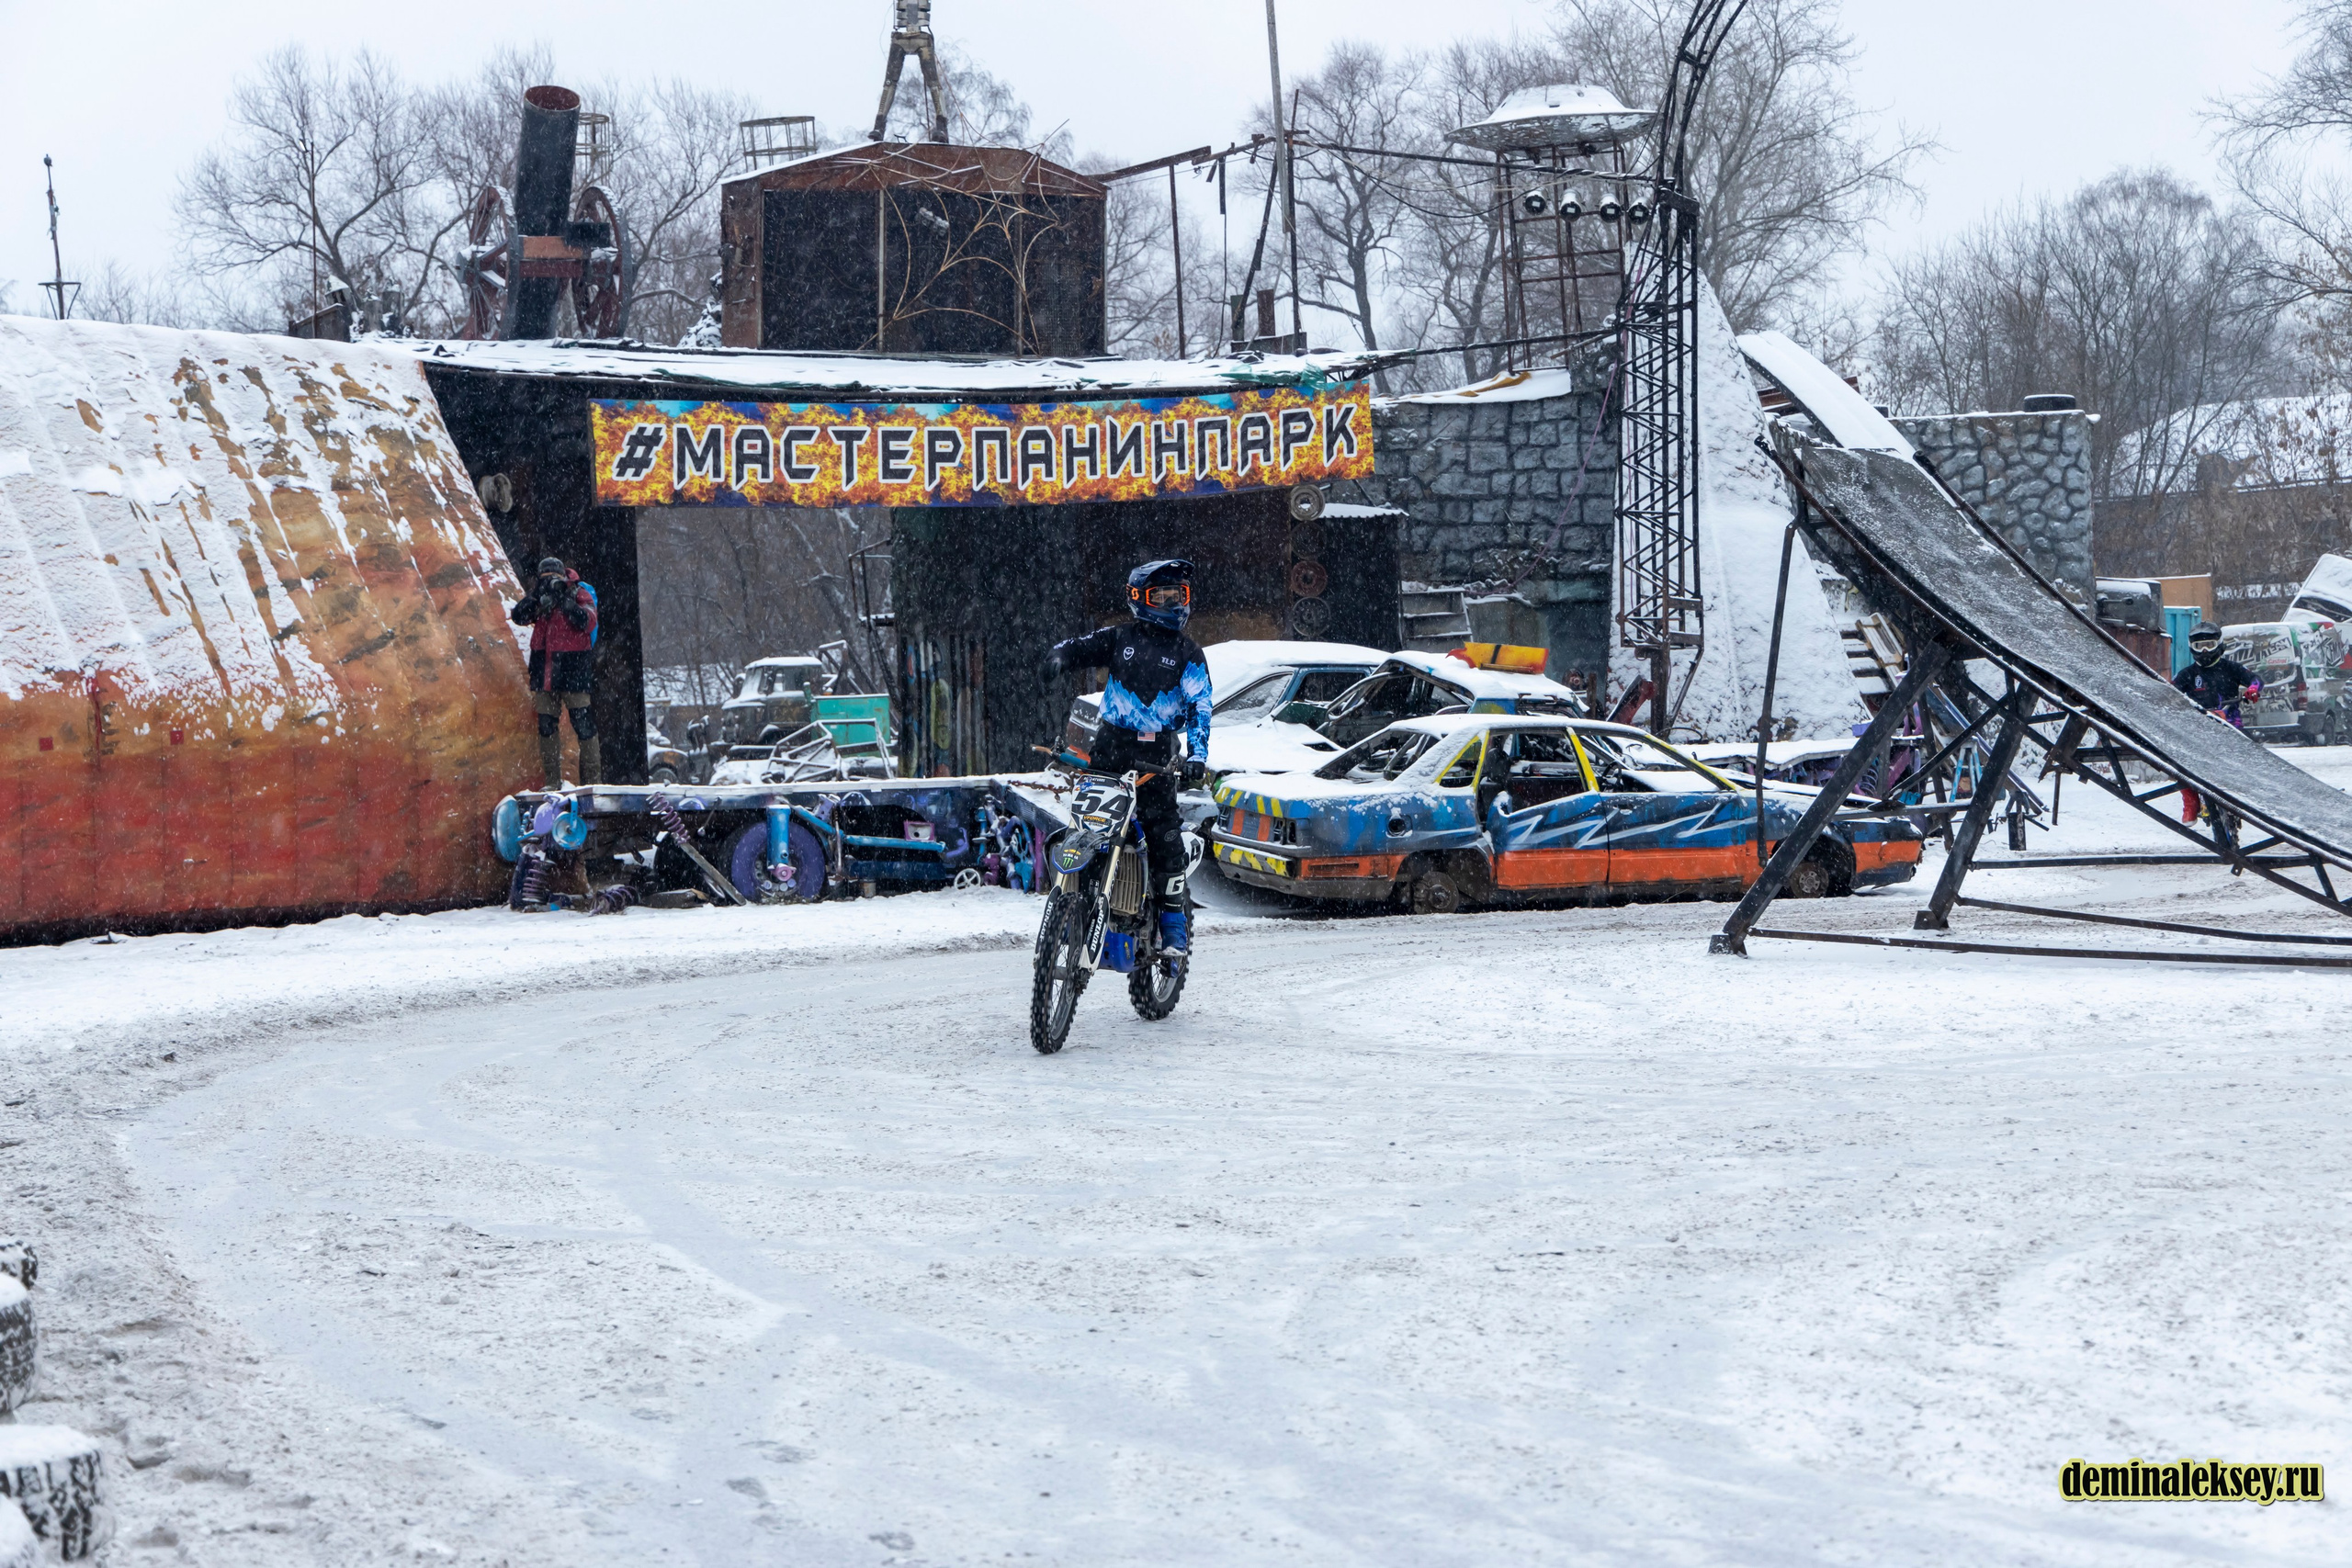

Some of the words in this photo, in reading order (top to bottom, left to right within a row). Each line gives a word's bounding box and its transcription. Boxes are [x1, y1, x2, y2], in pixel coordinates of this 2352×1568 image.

[613, 406, 1359, 491] #МАСТЕРПАНИНПАРК
[2263, 637, 2292, 658] TEAM
[1161, 656, 1176, 667] TLD
[1071, 790, 1135, 821] 54
[1165, 874, 1185, 896] G
[1090, 909, 1104, 953] DUNLOP
